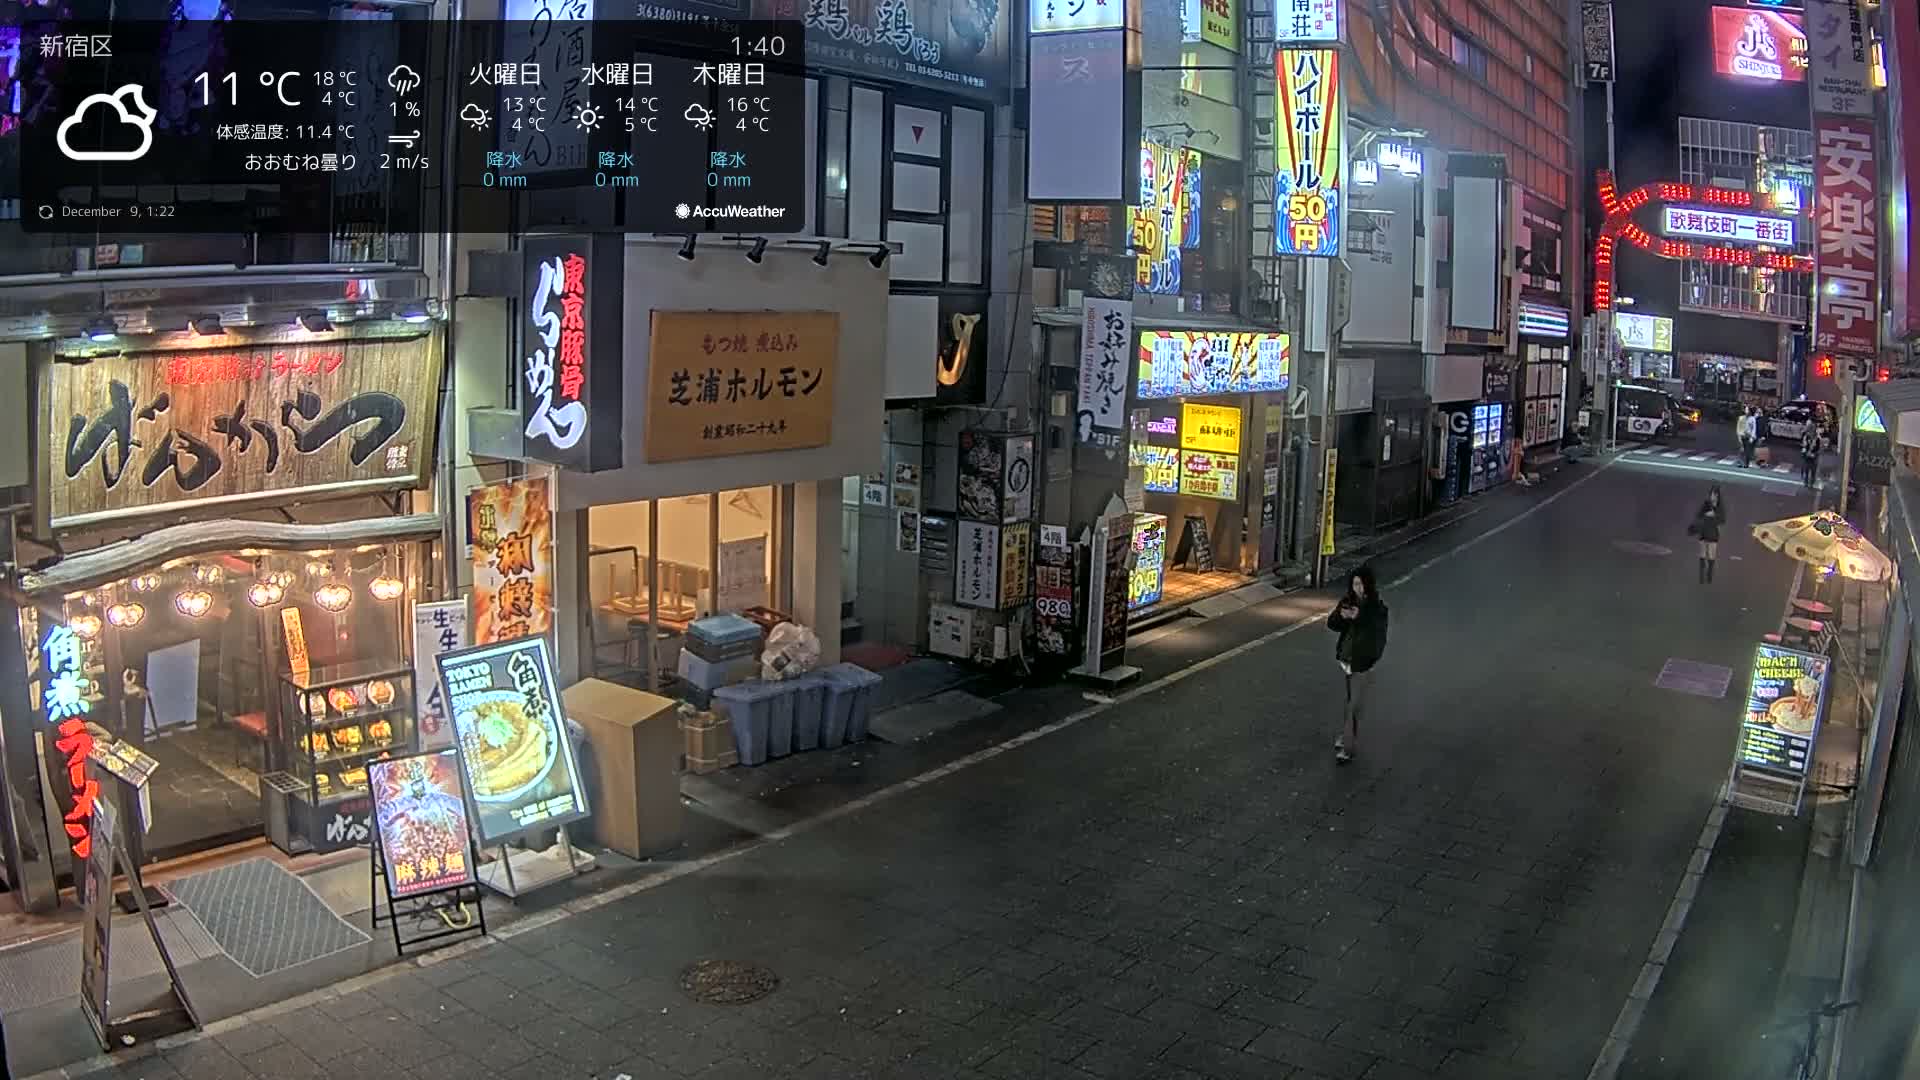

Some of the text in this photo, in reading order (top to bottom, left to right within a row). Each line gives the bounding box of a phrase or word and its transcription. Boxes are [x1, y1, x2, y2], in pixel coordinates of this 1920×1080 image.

[1589, 63, 1609, 78] 7F
[1295, 54, 1321, 190] ハイボール
[1670, 210, 1789, 241] 歌舞伎町一番街
[1817, 126, 1876, 330] 安楽亭
[560, 253, 586, 401] 東京豚骨
[1818, 332, 1836, 346] 2F
[668, 367, 823, 406] 芝浦ホルモン
[1096, 310, 1126, 415] お好み焼き
[971, 527, 984, 600] 芝浦ホルモン
[1042, 531, 1062, 545] 4階
[512, 655, 548, 720] 角煮
